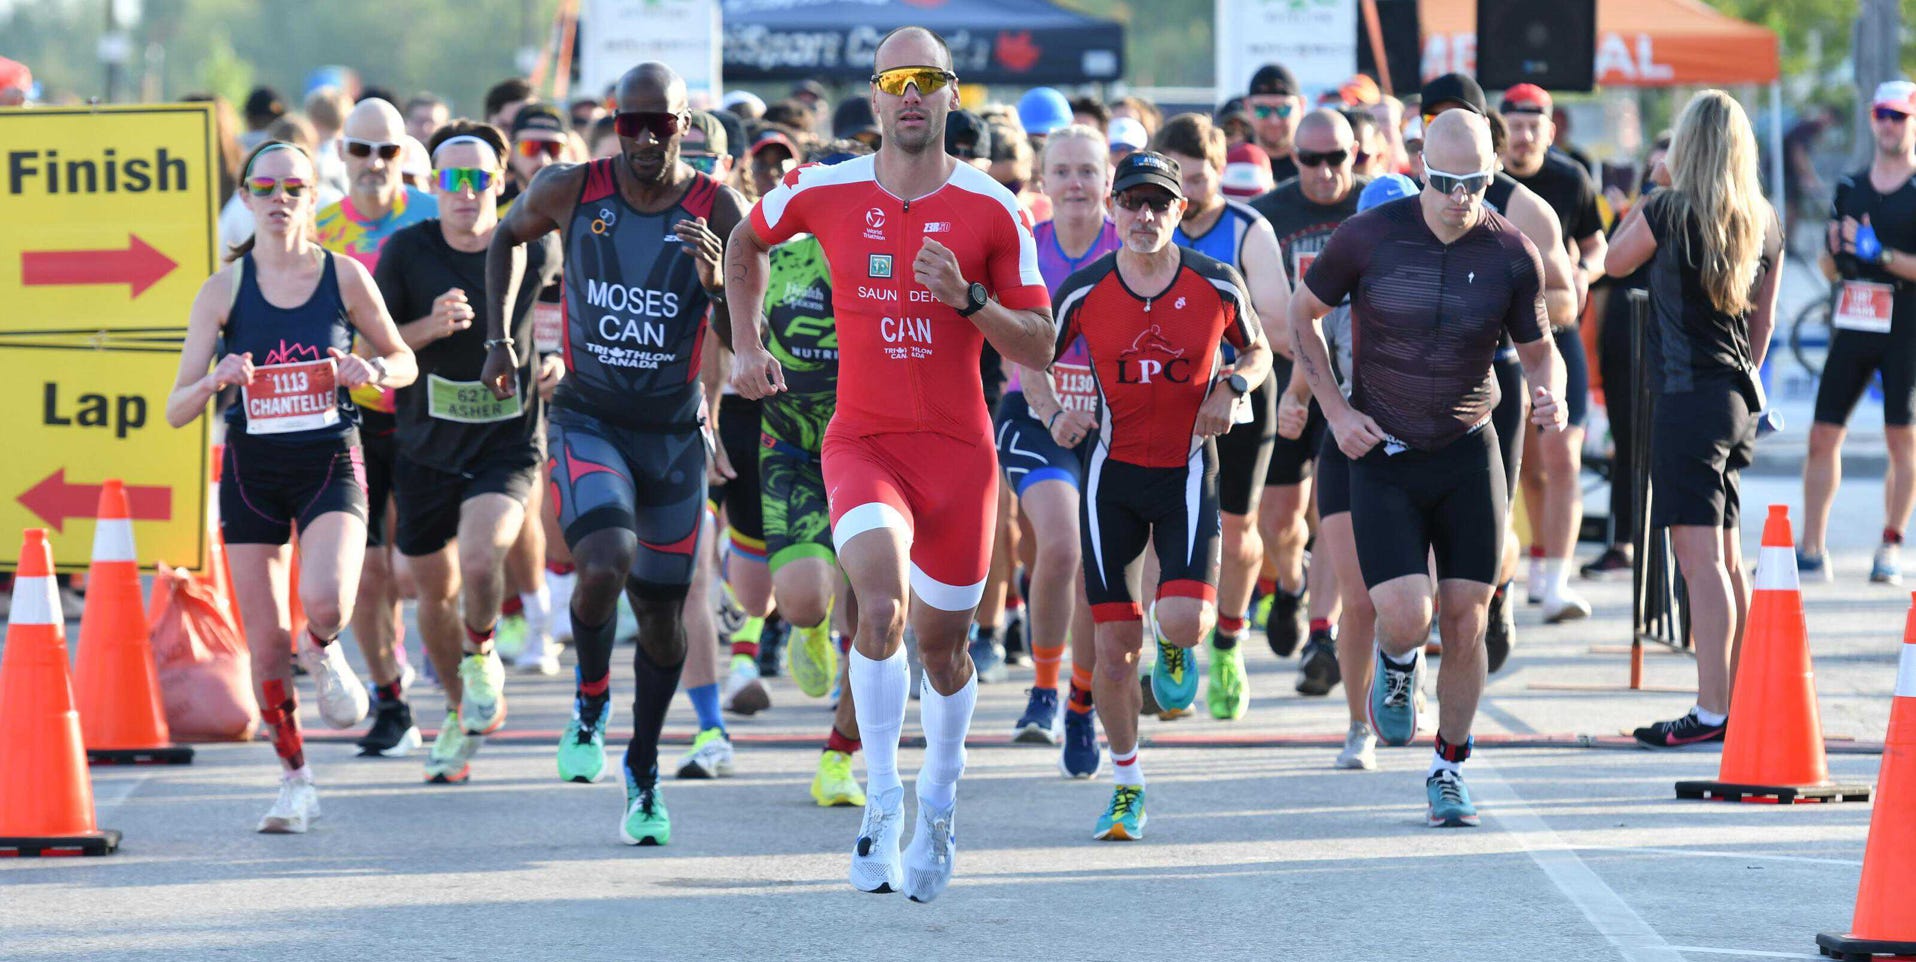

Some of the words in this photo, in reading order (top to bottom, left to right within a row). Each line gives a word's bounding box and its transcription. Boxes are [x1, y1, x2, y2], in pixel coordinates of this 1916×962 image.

[1419, 32, 1675, 81] MEAL
[8, 148, 188, 194] Finish
[863, 232, 886, 241] Triathlon
[587, 278, 679, 318] MOSES
[786, 281, 824, 301] Health
[909, 290, 944, 303] DER
[598, 314, 665, 348] CAN
[881, 317, 932, 344] CAN
[598, 355, 659, 370] CANADA
[791, 346, 839, 360] NUTRI
[273, 371, 309, 394] 1113
[1116, 358, 1190, 384] LPC
[457, 387, 490, 402] 627
[1061, 374, 1095, 393] 1130
[44, 381, 146, 439] Lap
[250, 390, 334, 417] CHANTELLE
[448, 403, 503, 418] ASHER
